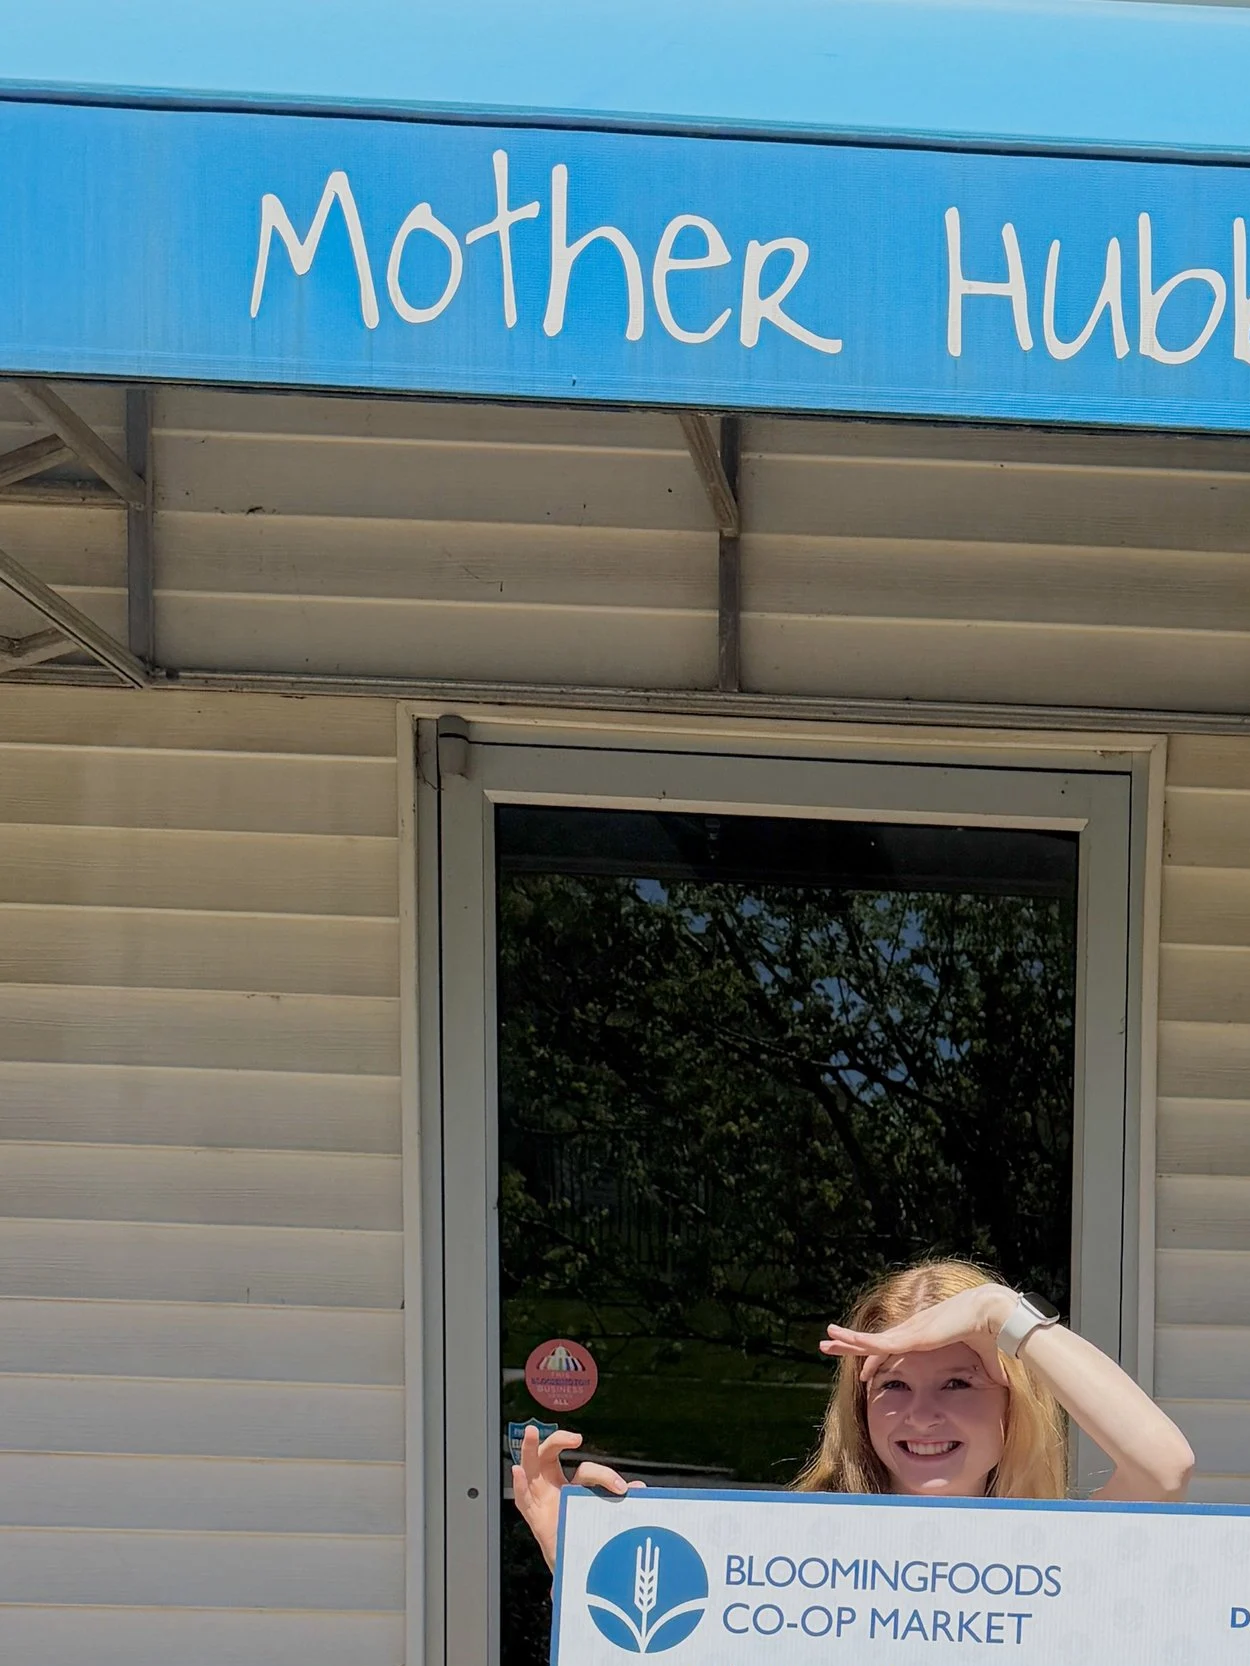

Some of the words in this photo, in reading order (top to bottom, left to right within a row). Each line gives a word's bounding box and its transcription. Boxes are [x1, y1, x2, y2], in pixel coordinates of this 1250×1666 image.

[553, 1398, 569, 1406] ALL
[725, 1555, 1062, 1598] BLOOMINGFOODS
[722, 1603, 857, 1640] CO-OP
[868, 1607, 1033, 1645] MARKET
